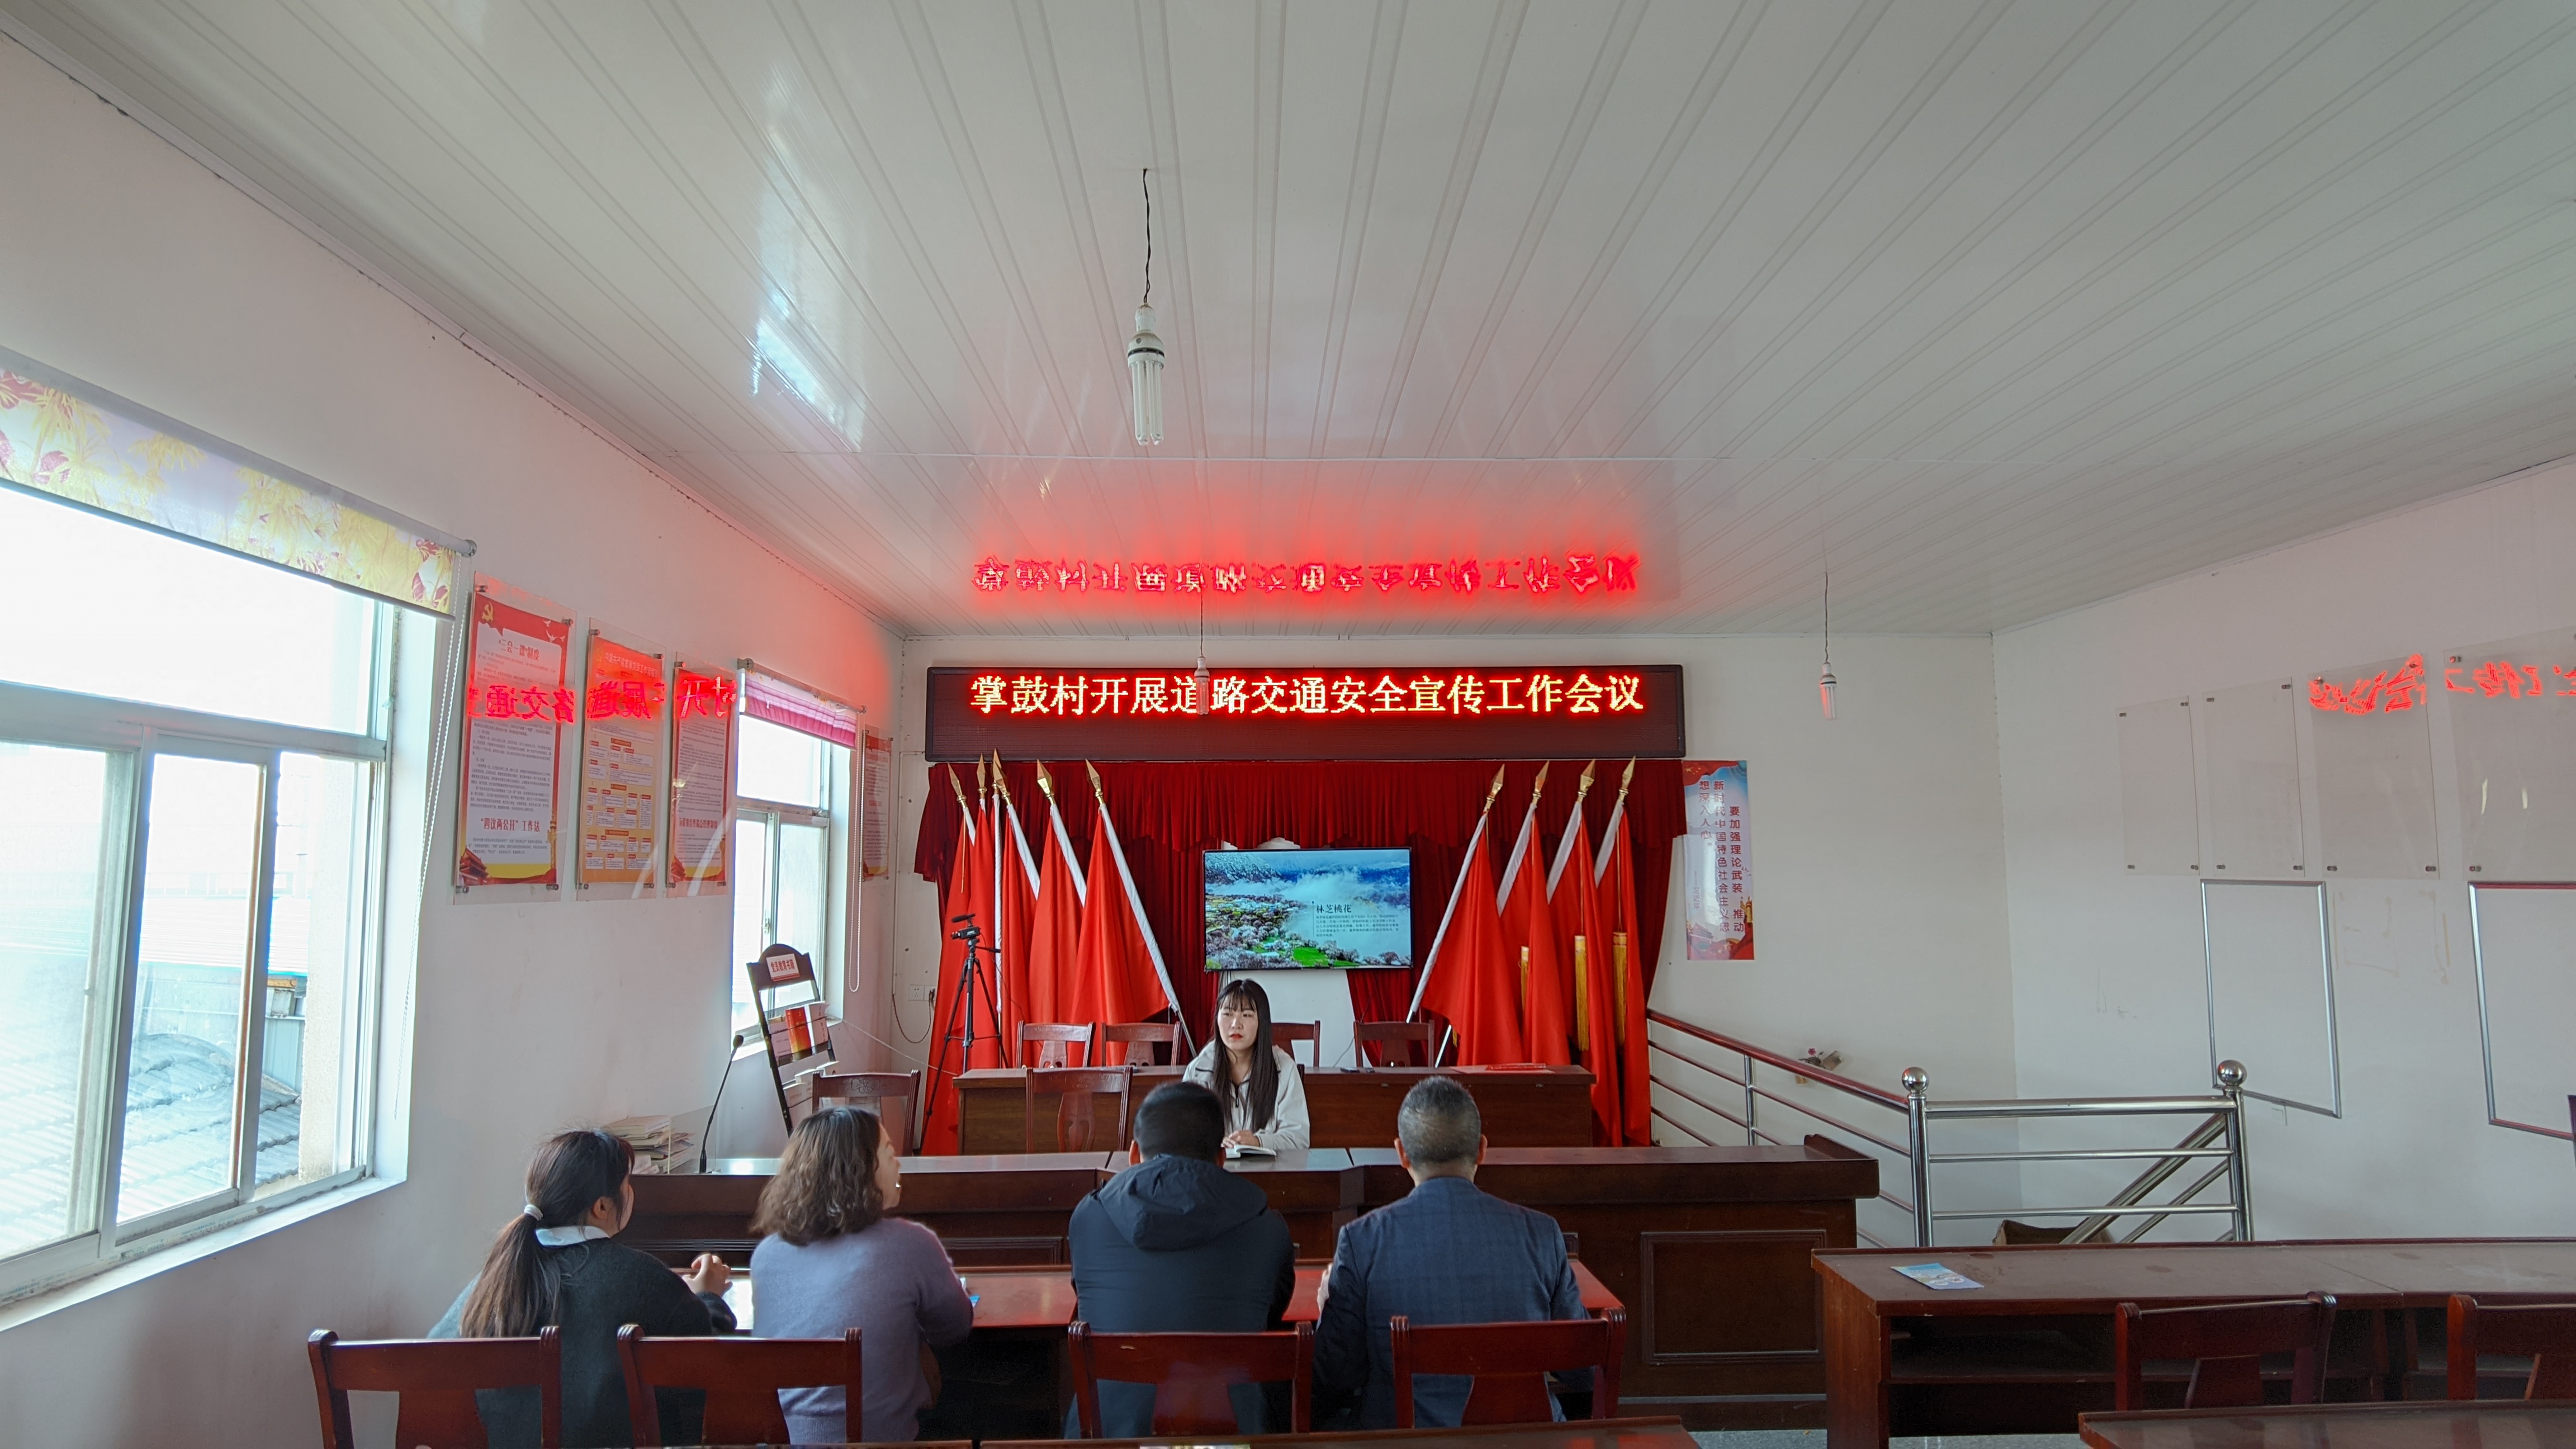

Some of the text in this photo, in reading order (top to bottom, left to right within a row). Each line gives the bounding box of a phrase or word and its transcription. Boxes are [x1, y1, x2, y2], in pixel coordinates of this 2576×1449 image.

[970, 674, 1643, 715] 掌鼓村开展道路交通安全宣传工作会议
[1316, 903, 1352, 913] 林芝桃花
